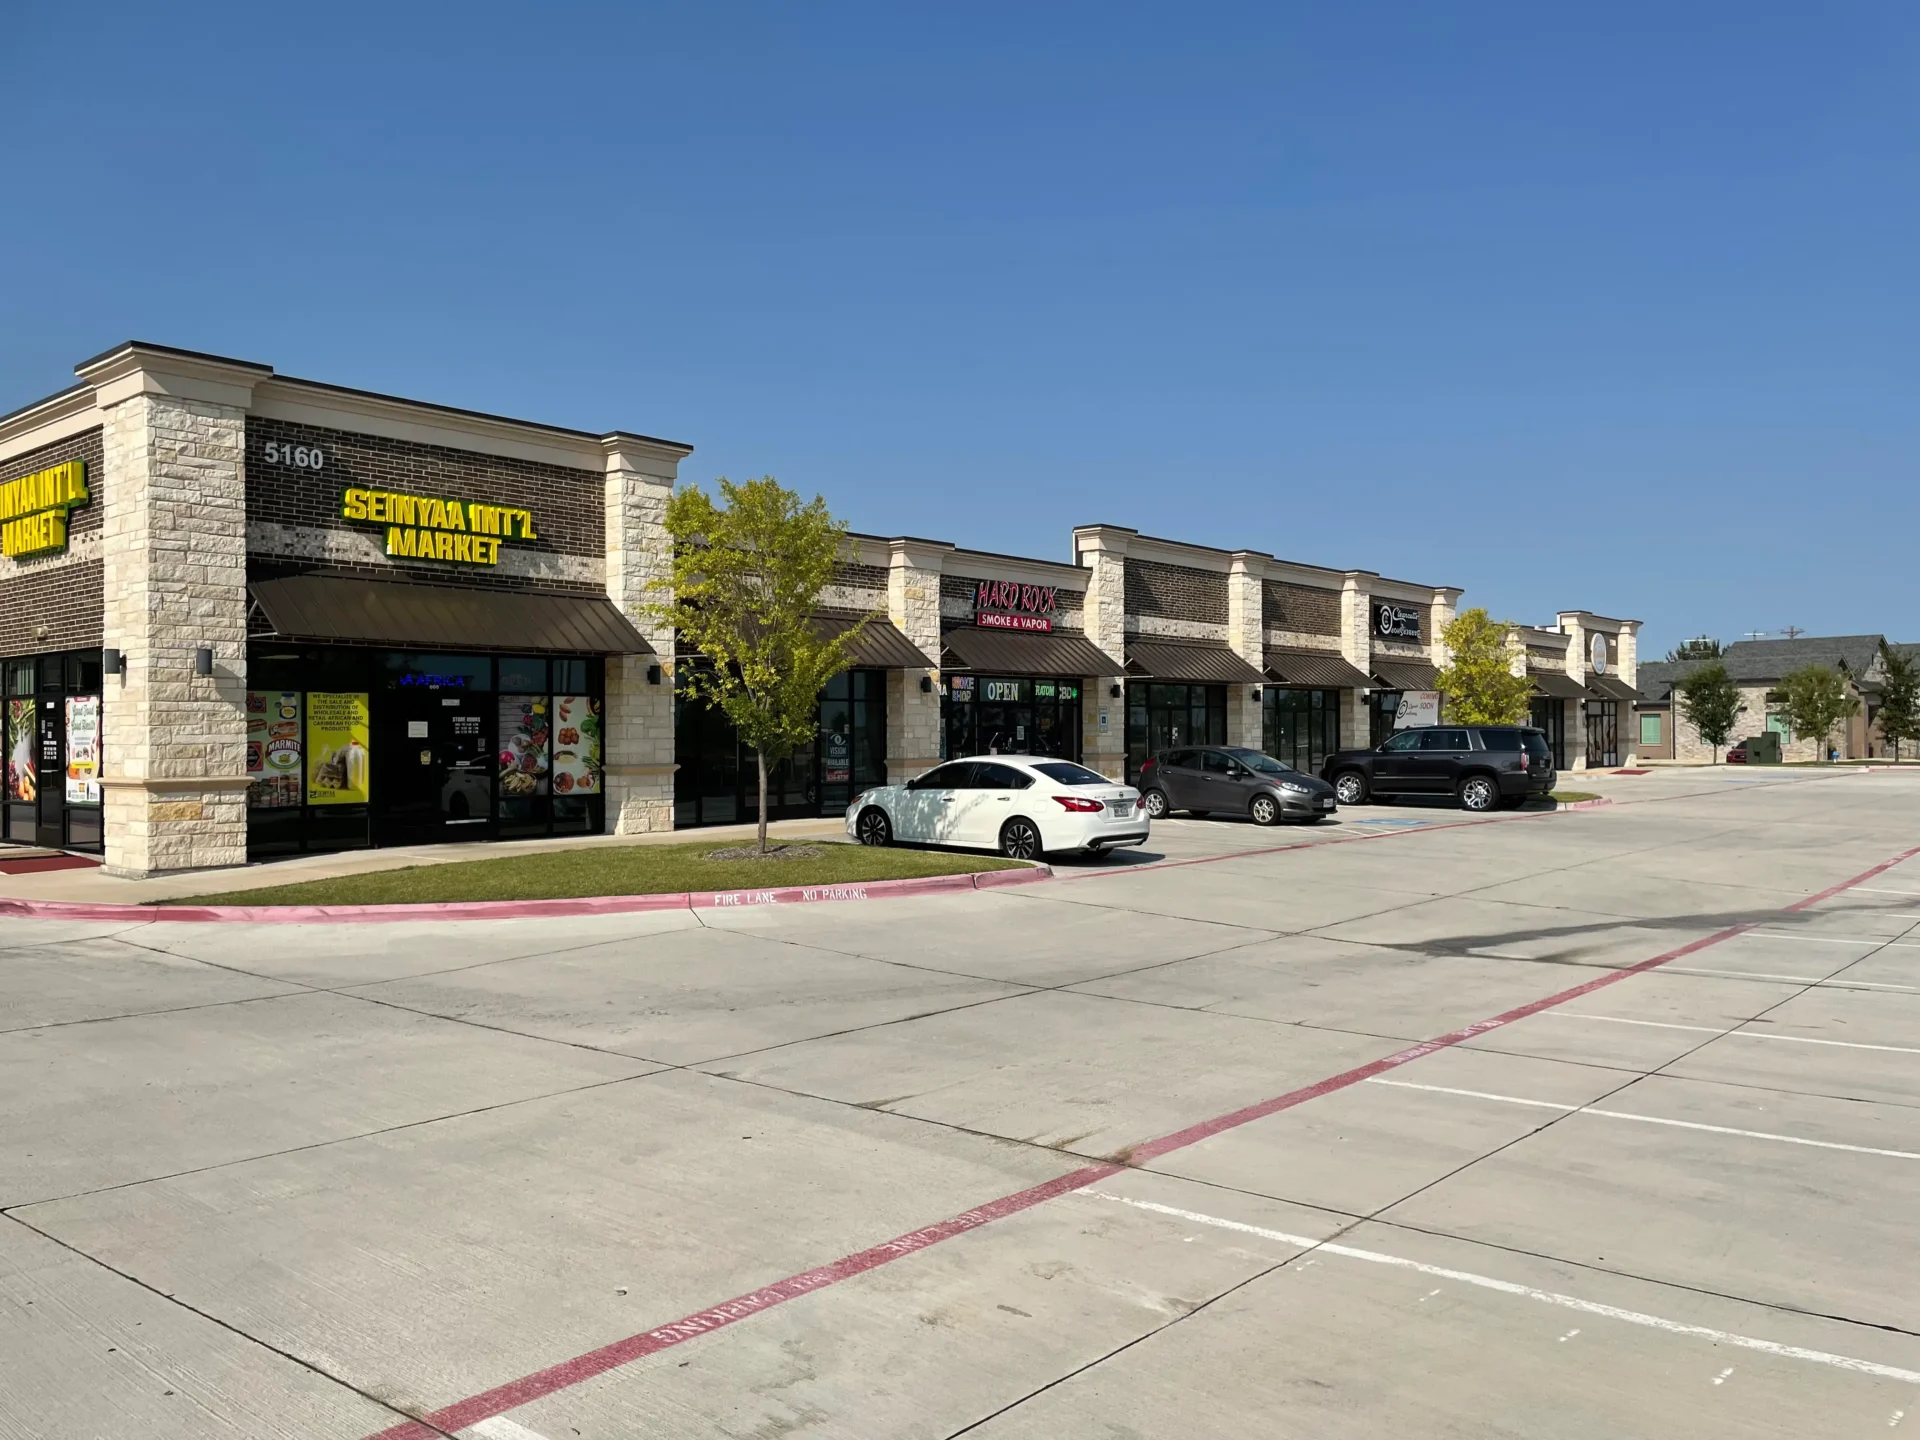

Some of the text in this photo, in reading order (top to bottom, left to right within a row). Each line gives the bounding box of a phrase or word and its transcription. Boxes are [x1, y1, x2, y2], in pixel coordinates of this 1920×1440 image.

[264, 443, 324, 470] 5160
[344, 488, 537, 540] SEINYAA INT'L
[2, 509, 65, 557] MARKET
[386, 527, 502, 565] MARKET
[977, 580, 1058, 613] HARD ROCK
[981, 614, 1048, 630] SMOKE & VAPOR
[416, 674, 464, 687] AFRICA
[952, 689, 972, 702] SHOP
[987, 682, 1019, 701] OPEN
[268, 740, 301, 752] MARMITE
[829, 746, 847, 755] VISION
[827, 758, 849, 766] AVAILABLE
[714, 888, 868, 907] FIRE LANE NO PARKING
